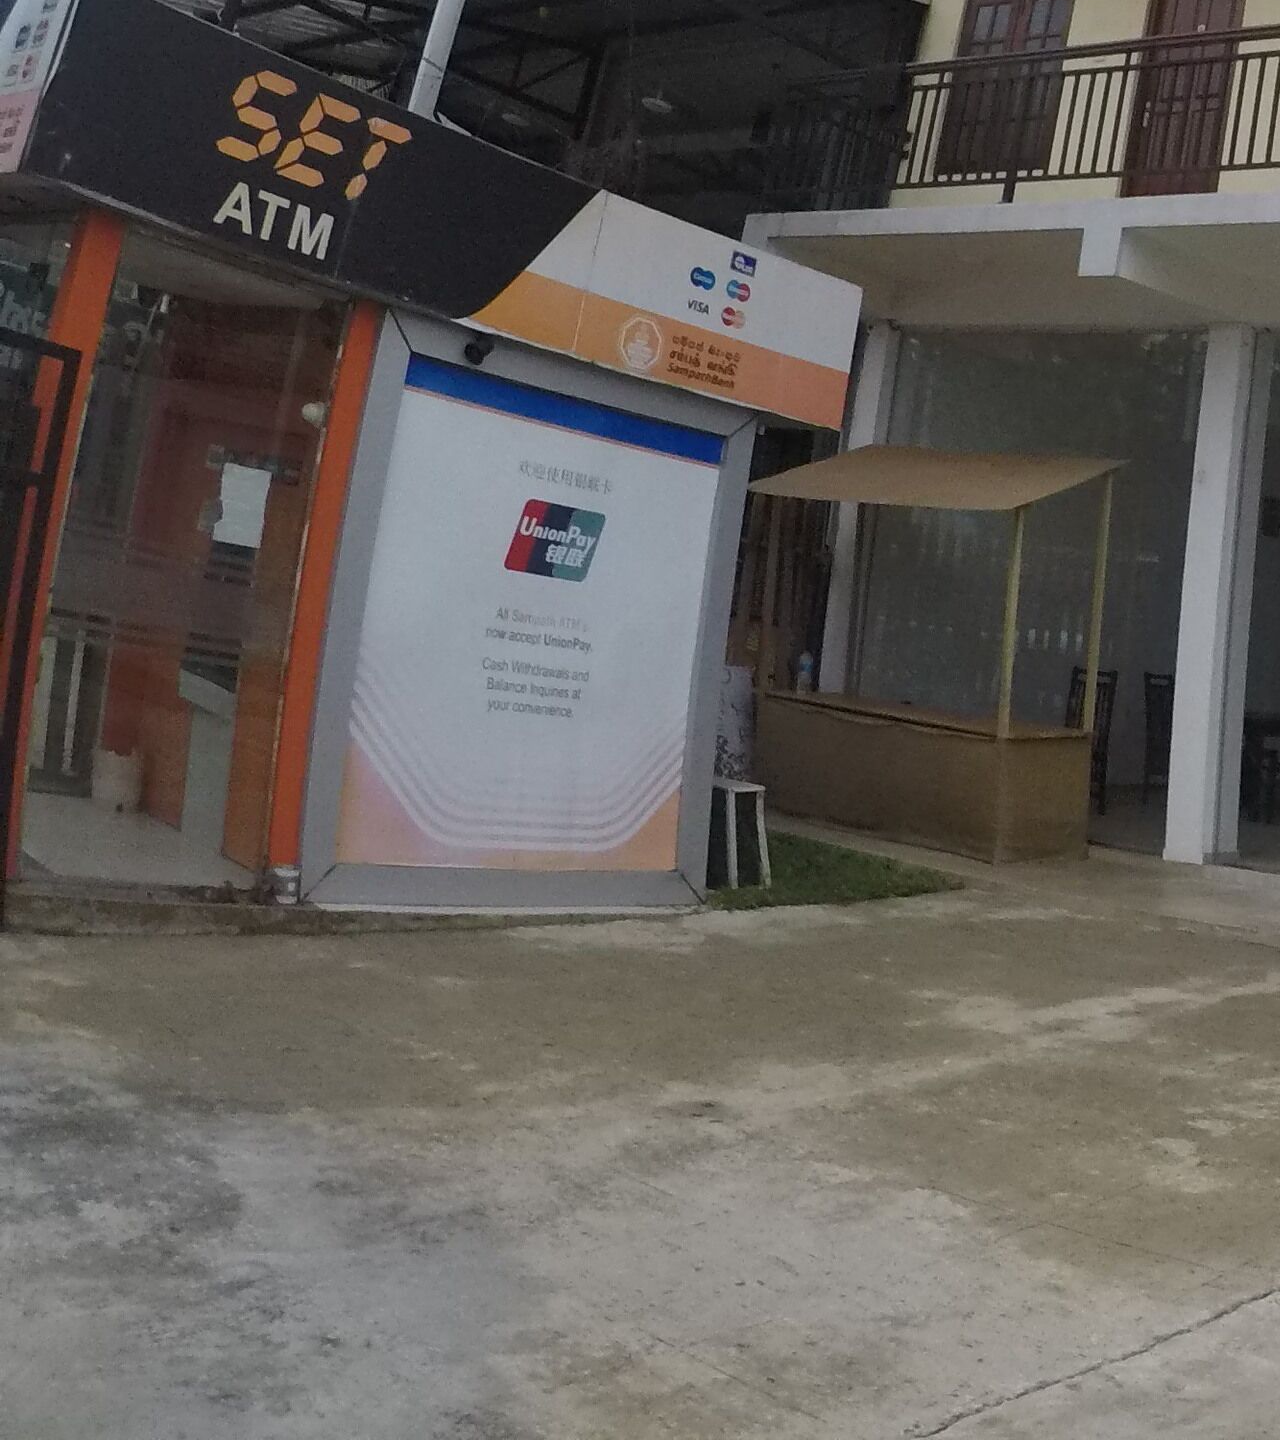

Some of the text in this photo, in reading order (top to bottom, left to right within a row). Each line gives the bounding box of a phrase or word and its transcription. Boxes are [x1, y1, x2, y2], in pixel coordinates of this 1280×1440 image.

[215, 70, 412, 201] SET
[212, 181, 335, 261] ATM
[687, 299, 710, 315] VISA
[519, 515, 597, 555] UnionPay
[545, 543, 587, 568] 银联
[485, 628, 507, 640] now
[508, 631, 541, 646] accept
[482, 657, 590, 682] Cash Withdrawals and
[486, 676, 528, 695] Balance
[487, 698, 511, 713] your
